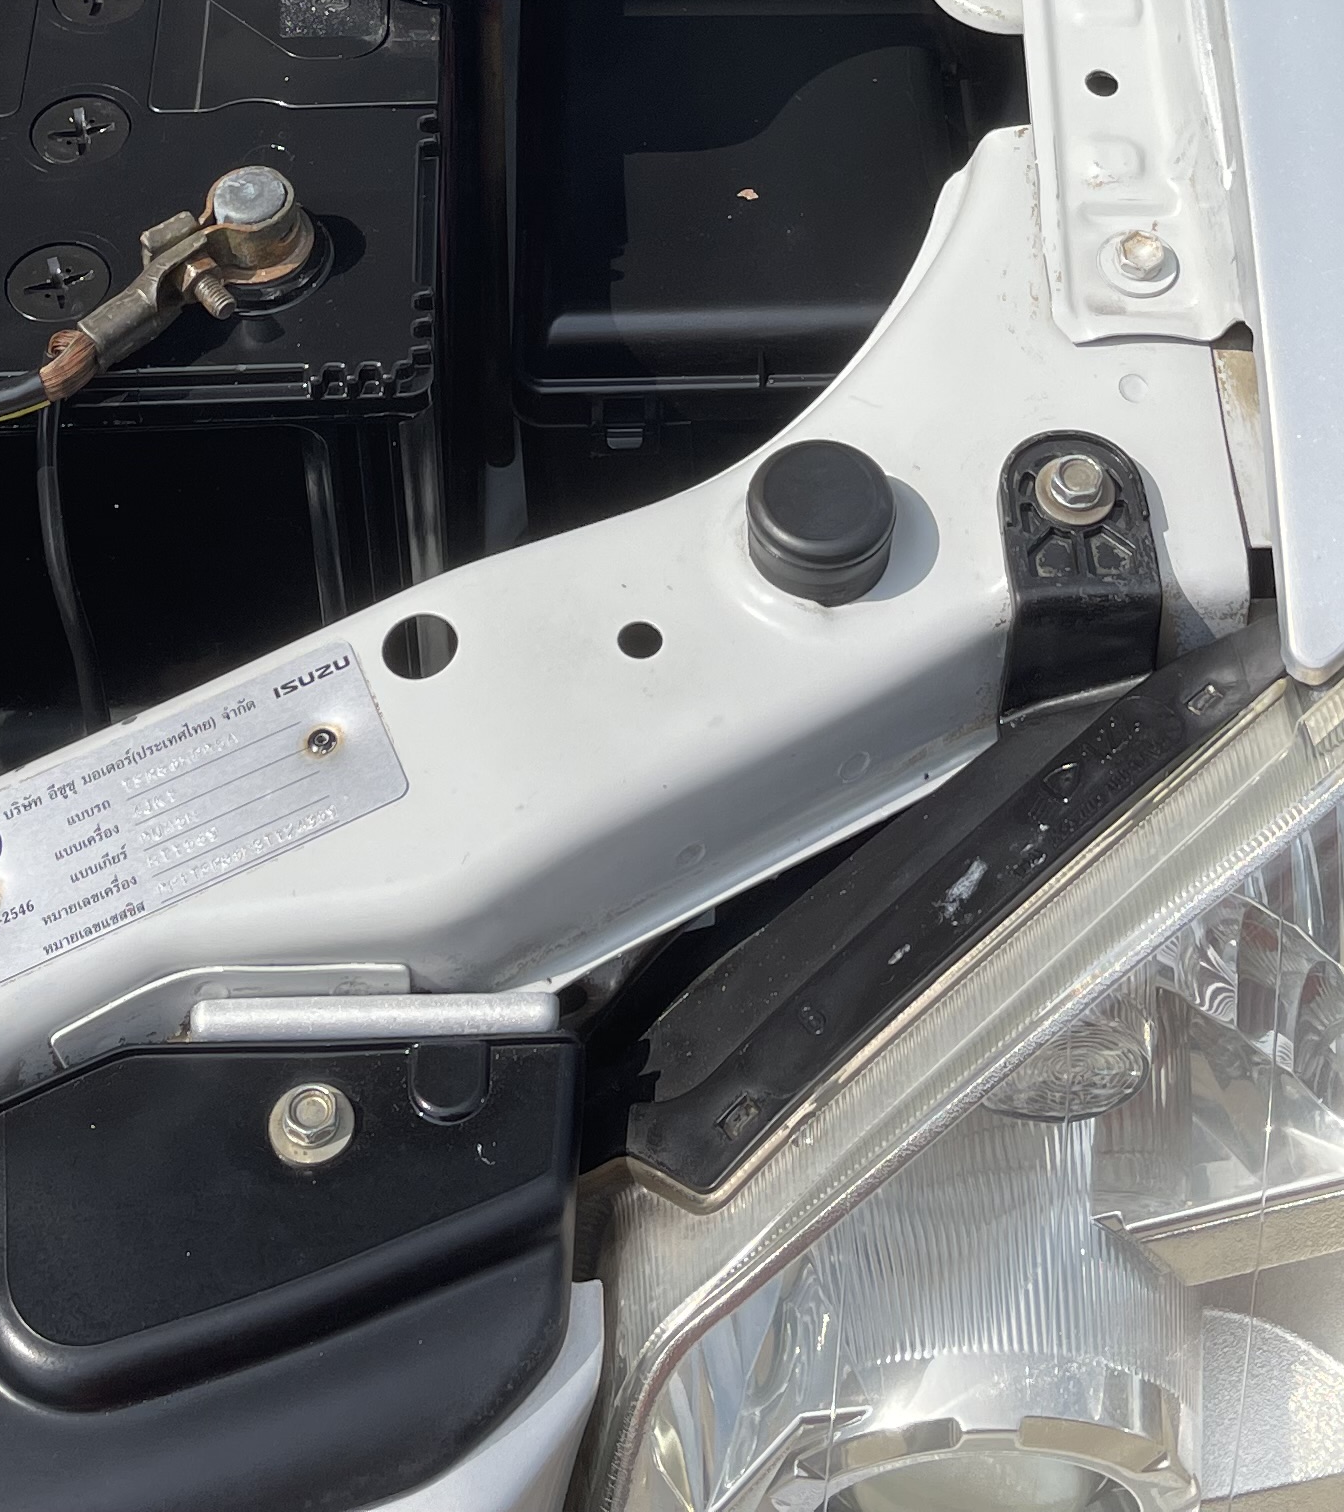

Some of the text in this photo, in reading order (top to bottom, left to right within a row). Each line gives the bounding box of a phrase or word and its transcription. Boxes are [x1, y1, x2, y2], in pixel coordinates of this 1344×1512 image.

[272, 655, 351, 699] ISUZU
[3, 794, 43, 821] บริษัท
[47, 779, 77, 802] อีซูซุ
[81, 716, 217, 784] มอเตอร์(ประเทศไทย)
[222, 698, 256, 721] จำกัด
[66, 798, 111, 826] แบบรถ
[54, 823, 120, 861] แบบเครื่อง
[70, 843, 129, 884] แบบเกียร์
[42, 874, 138, 926] หมายเลขเครื่อง
